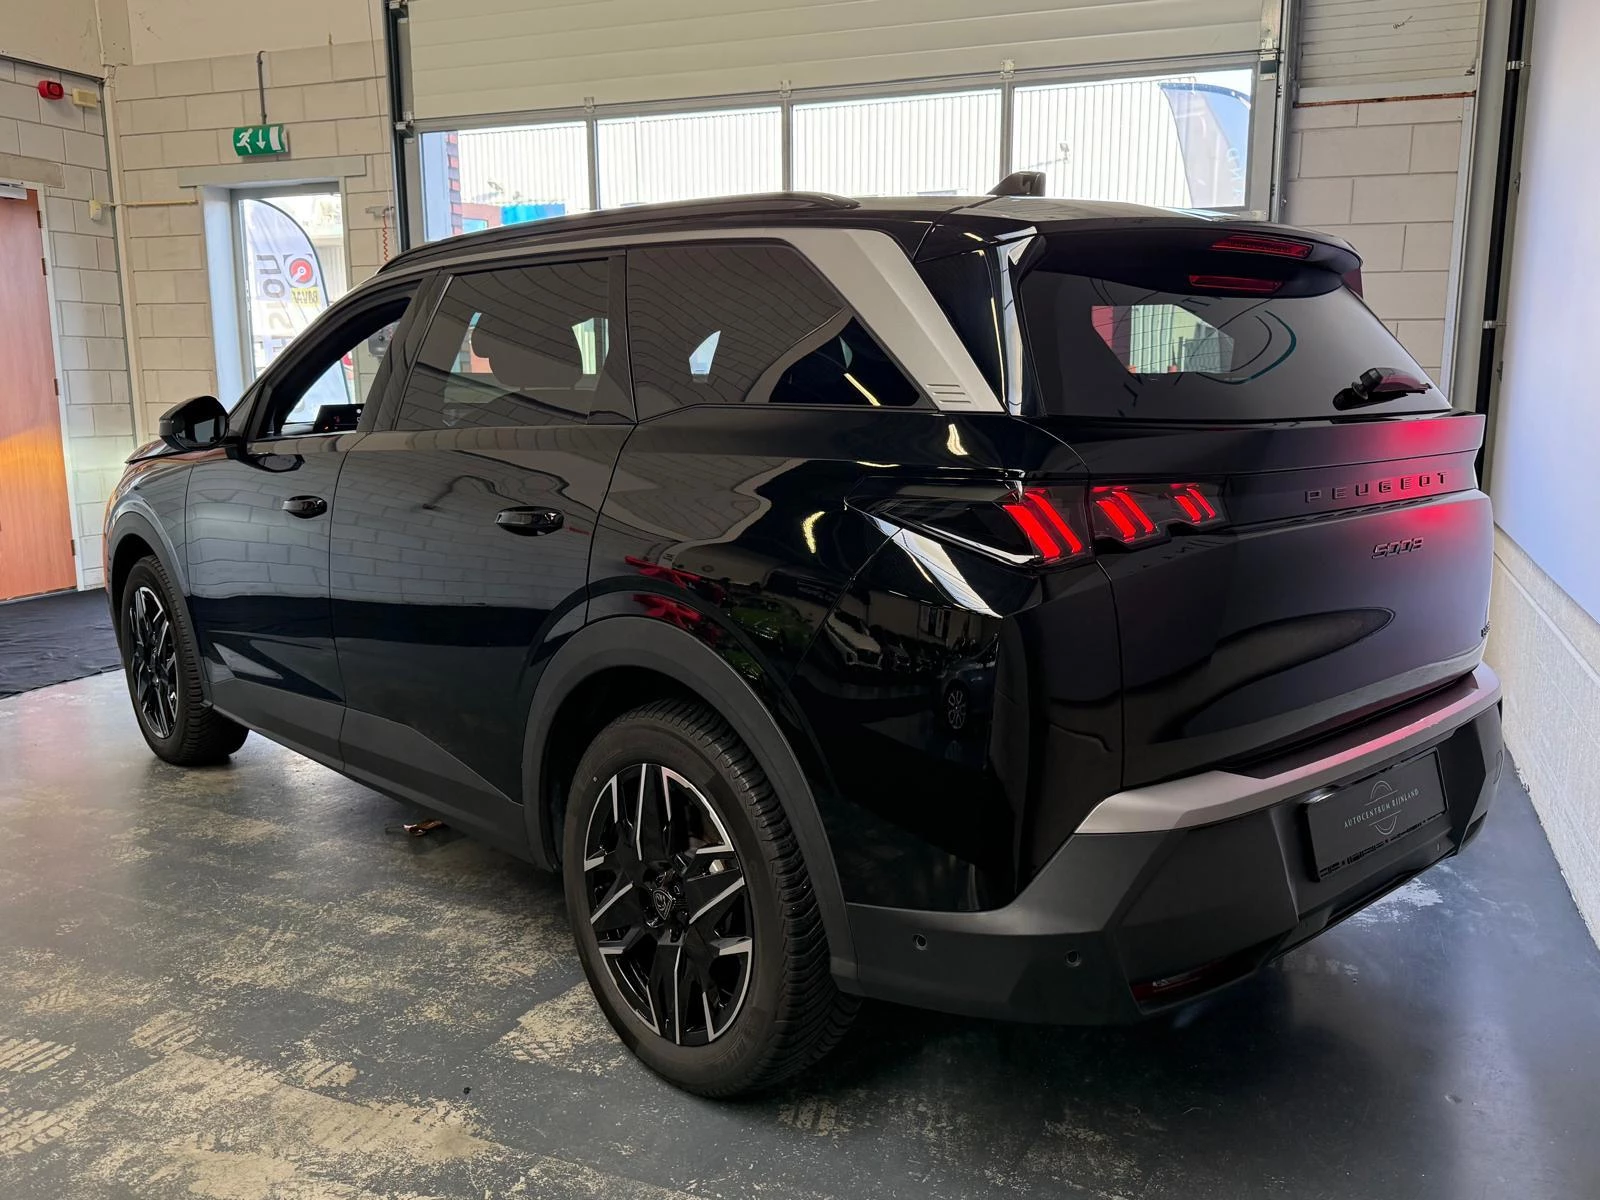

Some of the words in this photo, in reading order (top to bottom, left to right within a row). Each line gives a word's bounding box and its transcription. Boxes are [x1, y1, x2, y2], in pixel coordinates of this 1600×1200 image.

[1304, 471, 1447, 504] PEUGEOT
[1371, 537, 1424, 560] 5008
[1343, 803, 1391, 830] AUTOCENTRUM
